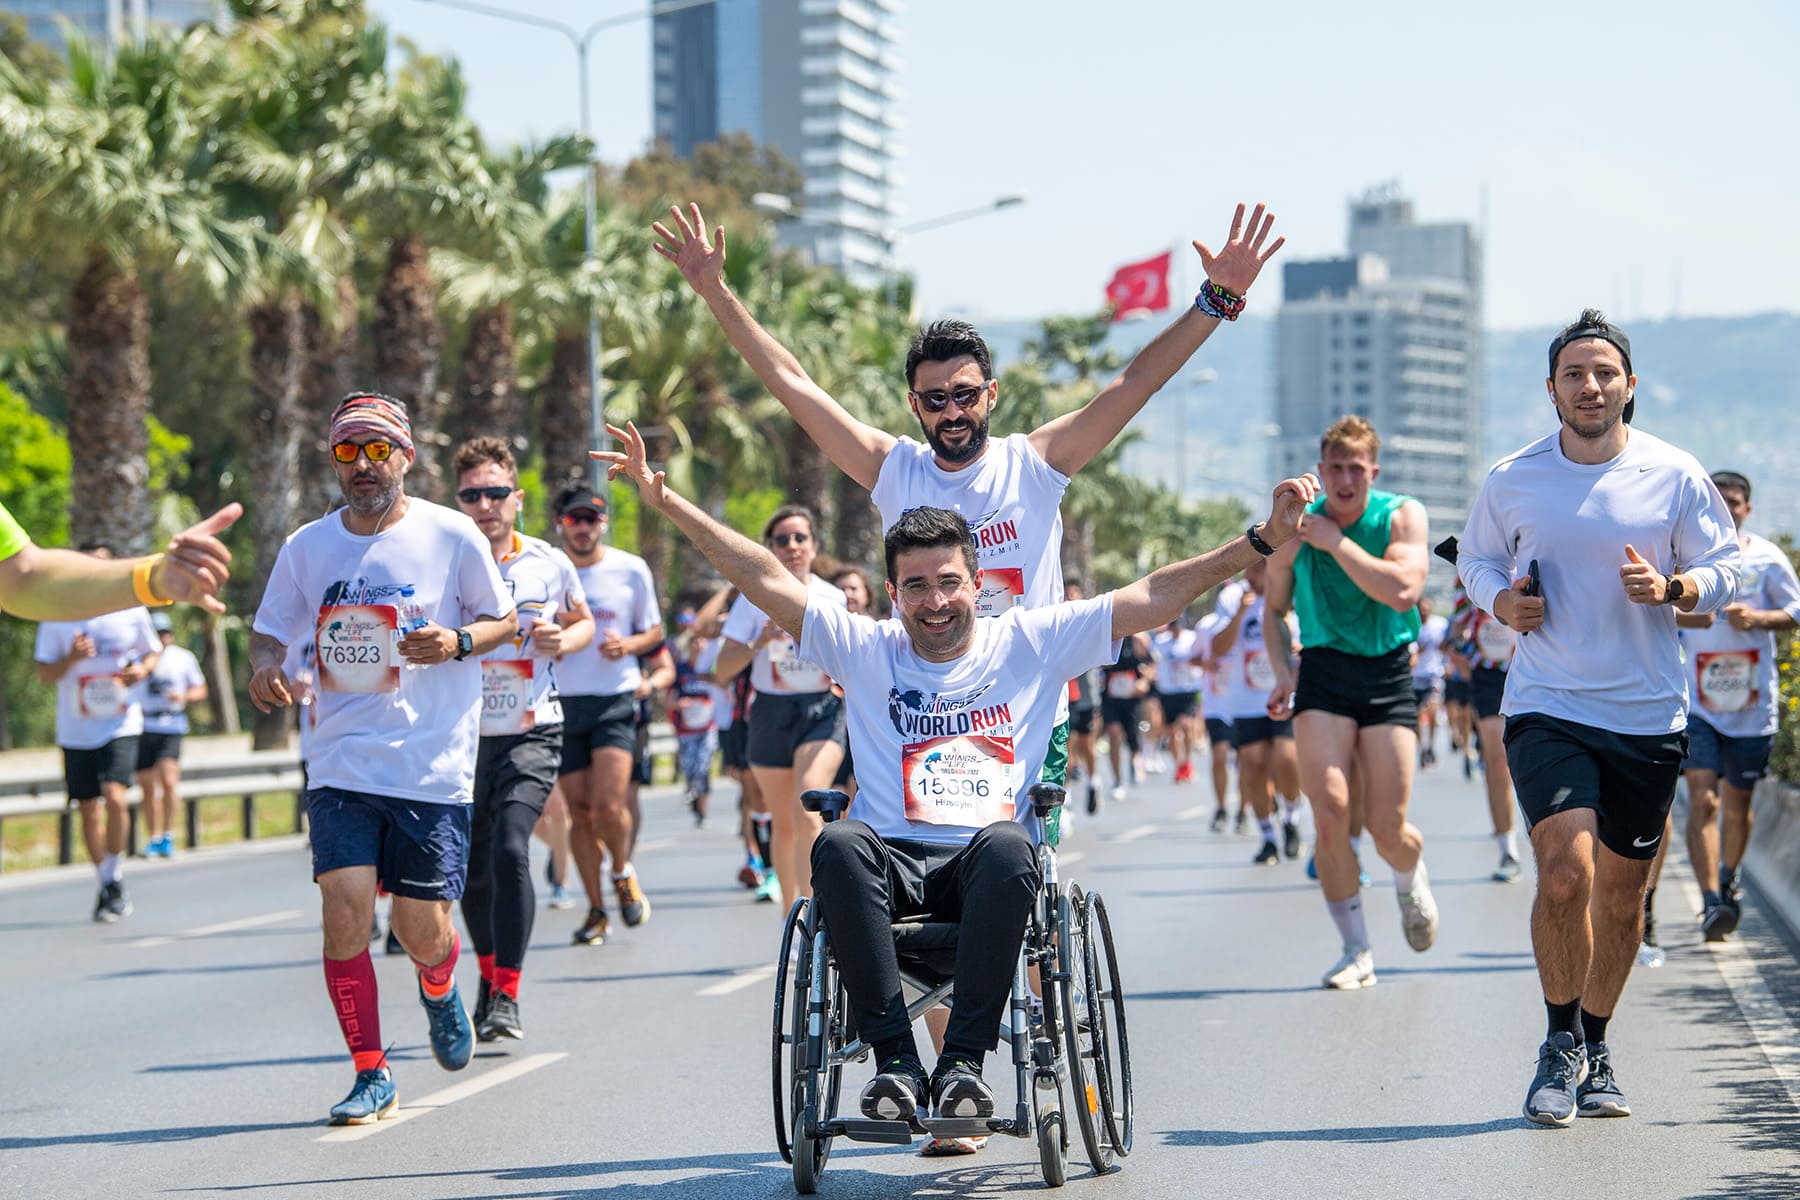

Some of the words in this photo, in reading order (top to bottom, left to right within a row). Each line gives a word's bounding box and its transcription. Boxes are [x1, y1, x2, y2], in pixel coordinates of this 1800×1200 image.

[322, 645, 381, 664] 76323
[944, 753, 977, 763] WINGS
[918, 777, 990, 797] 15696
[1003, 786, 1014, 801] 4
[329, 976, 364, 1047] kalenji
